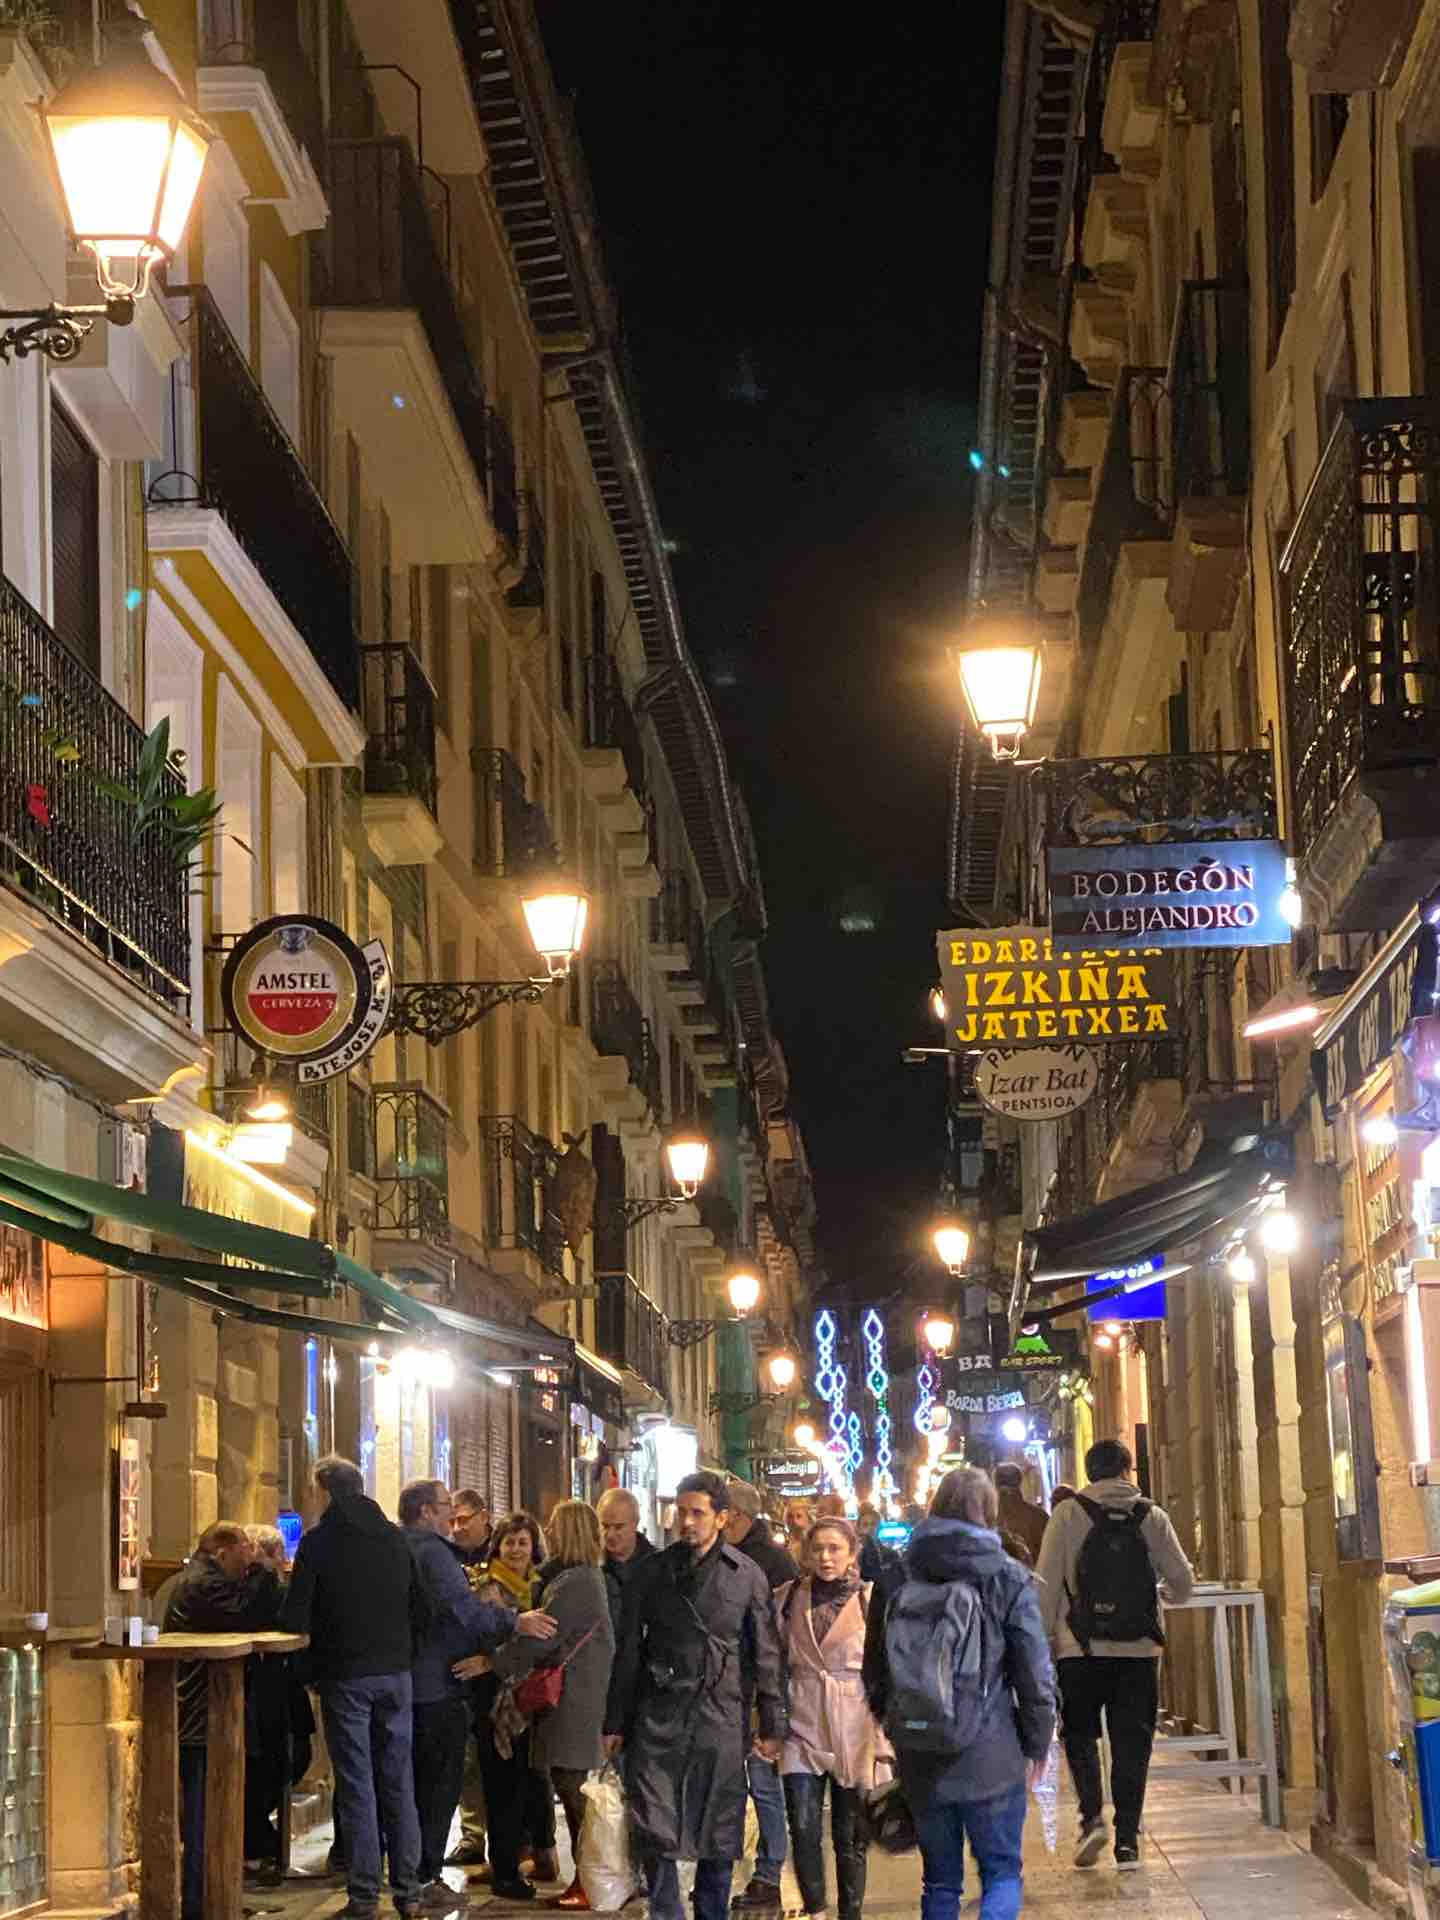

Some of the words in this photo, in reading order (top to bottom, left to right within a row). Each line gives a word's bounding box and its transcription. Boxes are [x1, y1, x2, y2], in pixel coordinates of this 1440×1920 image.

[1071, 861, 1255, 898] BODEGÓN
[1081, 902, 1260, 936] ALEJANDRO
[256, 972, 331, 990] AMSTEL
[368, 957, 387, 1014] MRI
[964, 961, 1151, 1006] IZKIÑA
[262, 998, 321, 1009] CERVEZA
[956, 1003, 1169, 1042] JATETXEA
[989, 1074, 1041, 1095] Izar
[1001, 1096, 1075, 1112] PENTSIOA
[957, 1354, 993, 1371] BA
